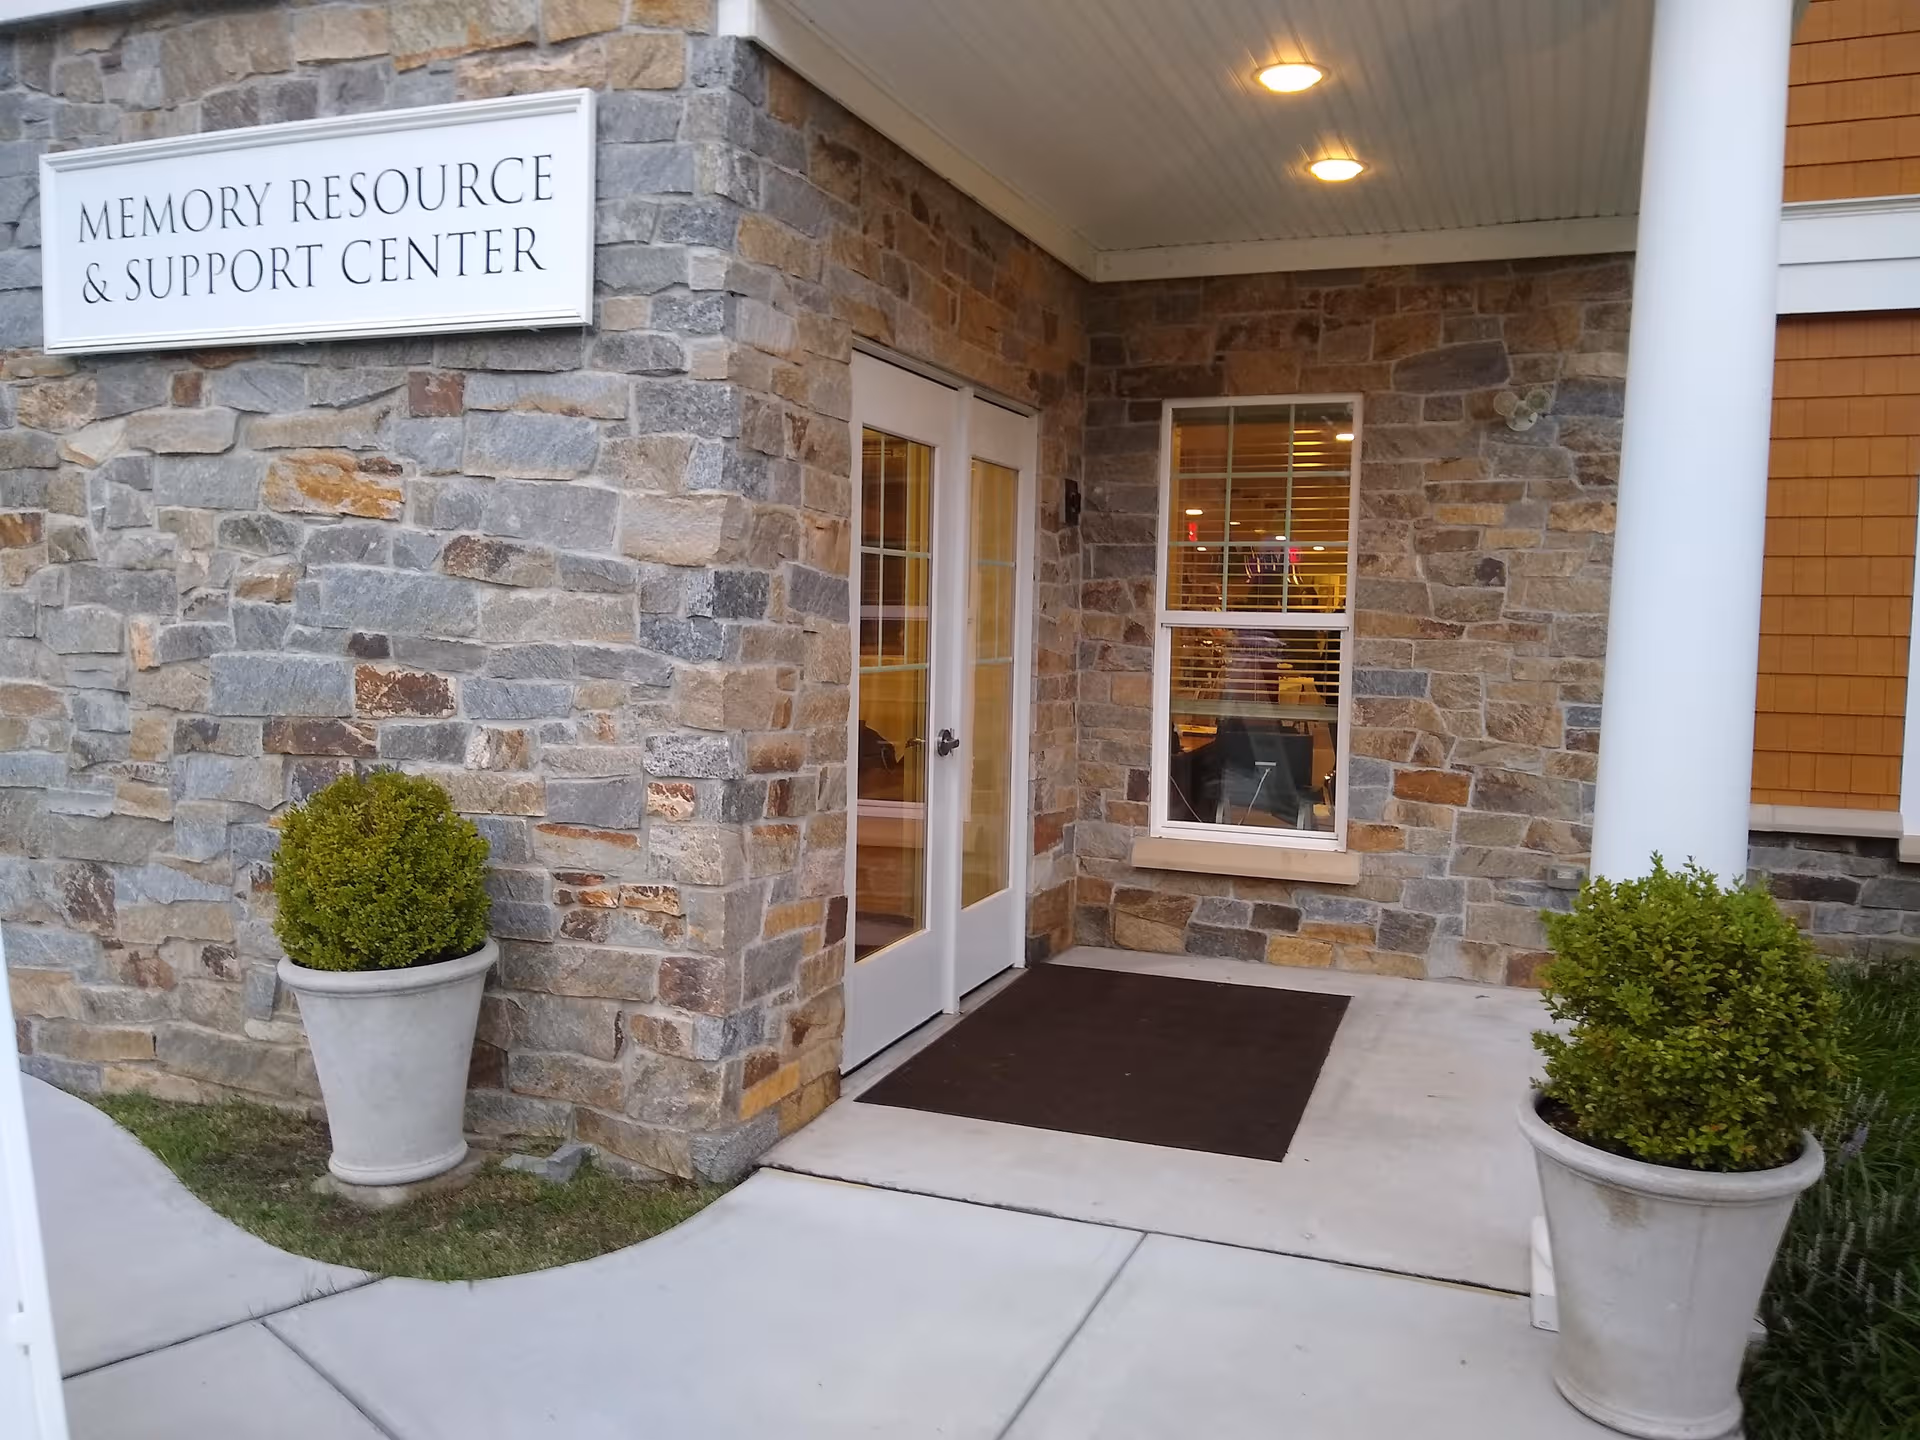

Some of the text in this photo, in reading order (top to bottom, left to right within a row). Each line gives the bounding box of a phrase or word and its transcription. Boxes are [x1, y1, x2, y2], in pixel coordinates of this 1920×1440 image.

[78, 154, 553, 243] MEMORY RESOURCE
[83, 226, 547, 304] & SUPPORT CENTER
